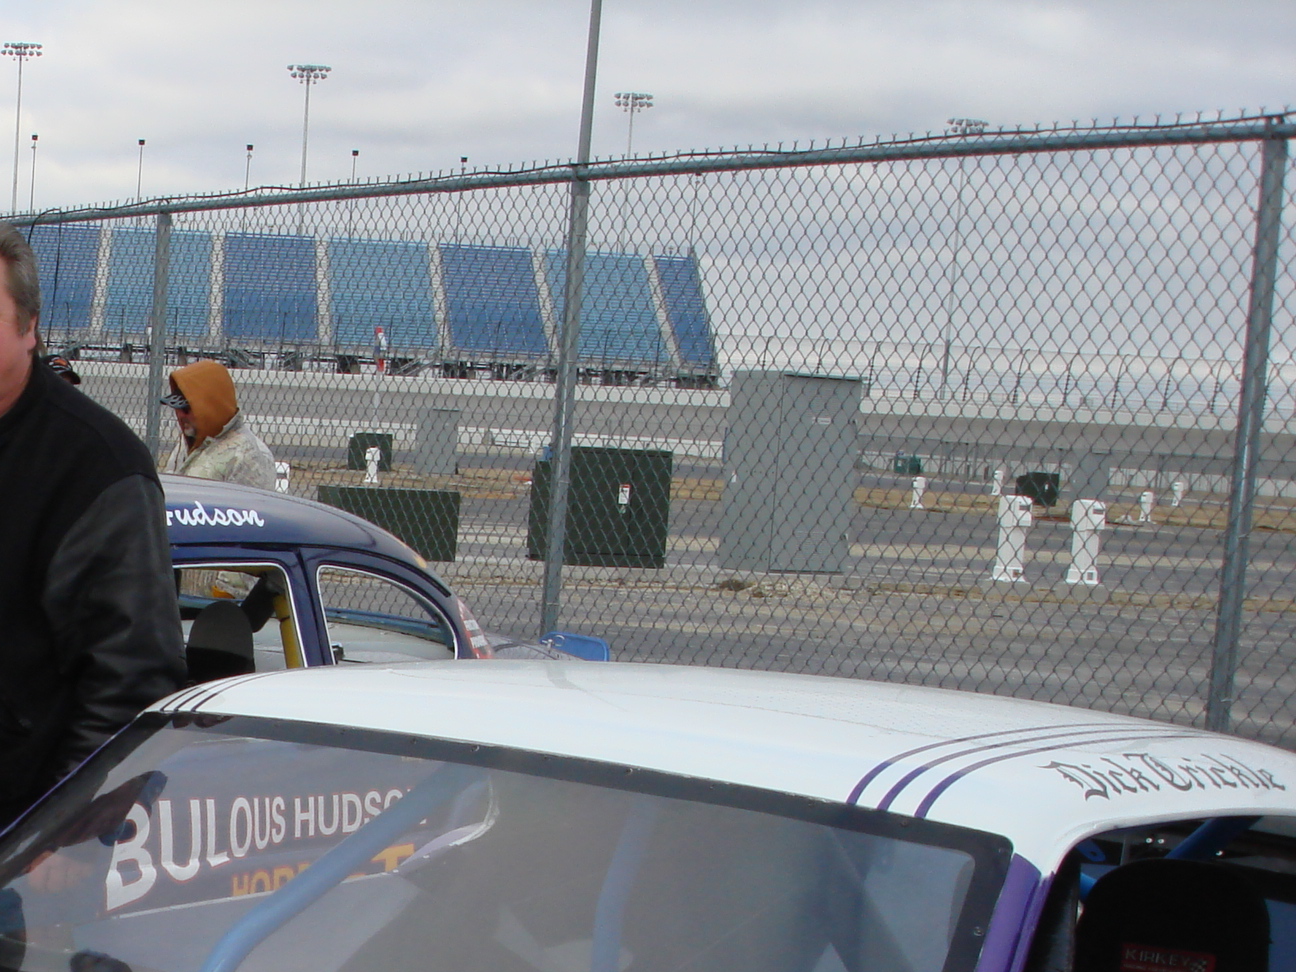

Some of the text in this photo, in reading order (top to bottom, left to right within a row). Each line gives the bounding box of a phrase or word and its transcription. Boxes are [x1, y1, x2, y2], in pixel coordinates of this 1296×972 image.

[1036, 752, 1286, 801] Dick Trickle
[294, 788, 427, 840] HUDS
[1124, 947, 1191, 967] KIRKEY
